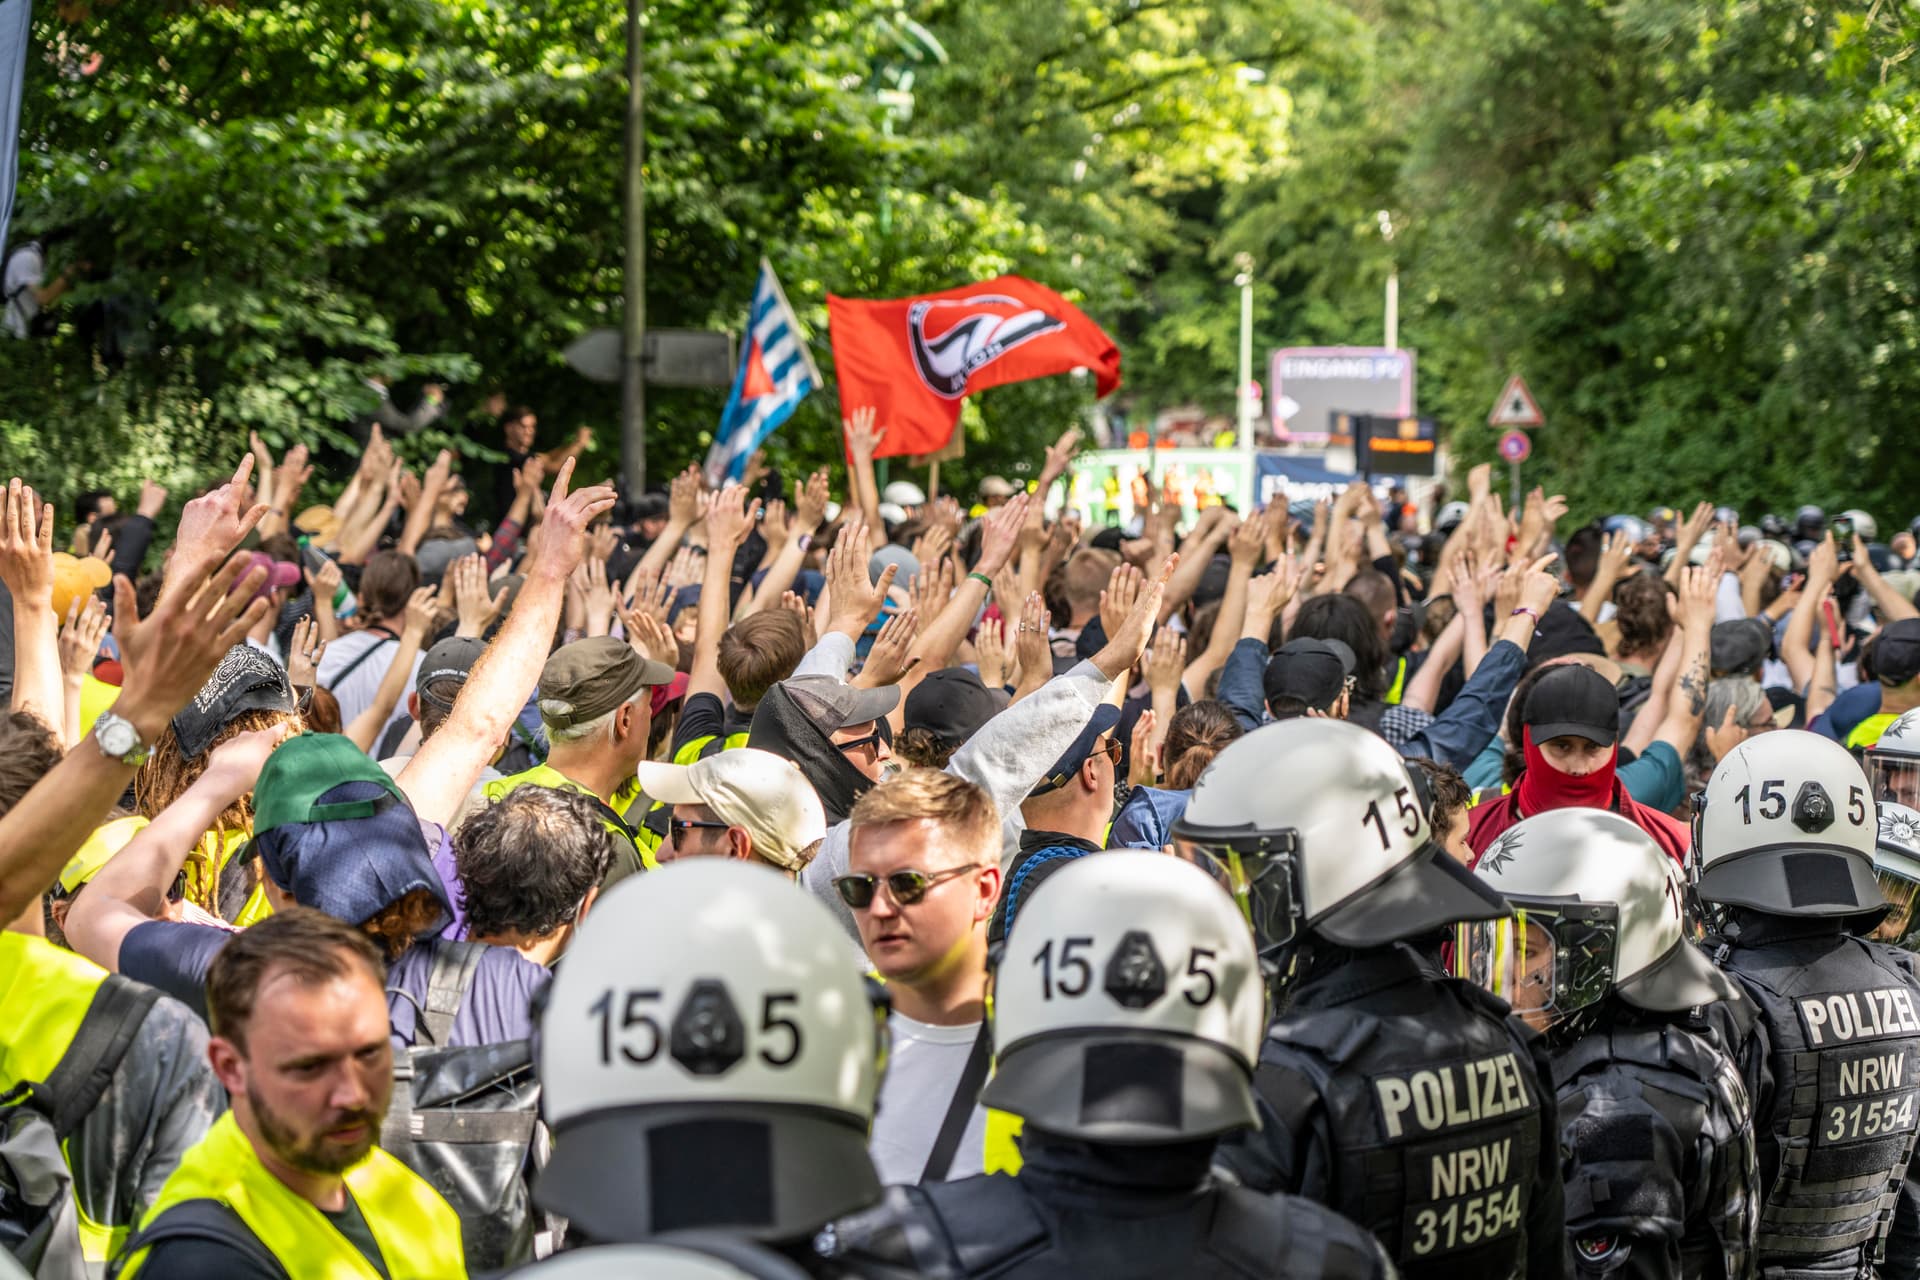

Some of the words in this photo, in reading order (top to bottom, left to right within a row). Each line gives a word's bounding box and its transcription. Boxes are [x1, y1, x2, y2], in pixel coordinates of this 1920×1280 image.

[1281, 358, 1373, 379] EINGANG
[1362, 786, 1420, 851] 15
[1735, 780, 1786, 825] 15
[1848, 785, 1865, 826] 5
[1033, 937, 1094, 1001] 15
[1183, 947, 1216, 1007] 5
[589, 988, 662, 1066] 15
[760, 993, 804, 1067] 5
[1801, 988, 1920, 1044] POLIZEI
[1376, 1052, 1530, 1138] POLIZEI
[1839, 1053, 1904, 1096] NRW
[1827, 1094, 1914, 1141] 31554
[1432, 1138, 1511, 1200] NRW
[1413, 1184, 1521, 1254] 31554
